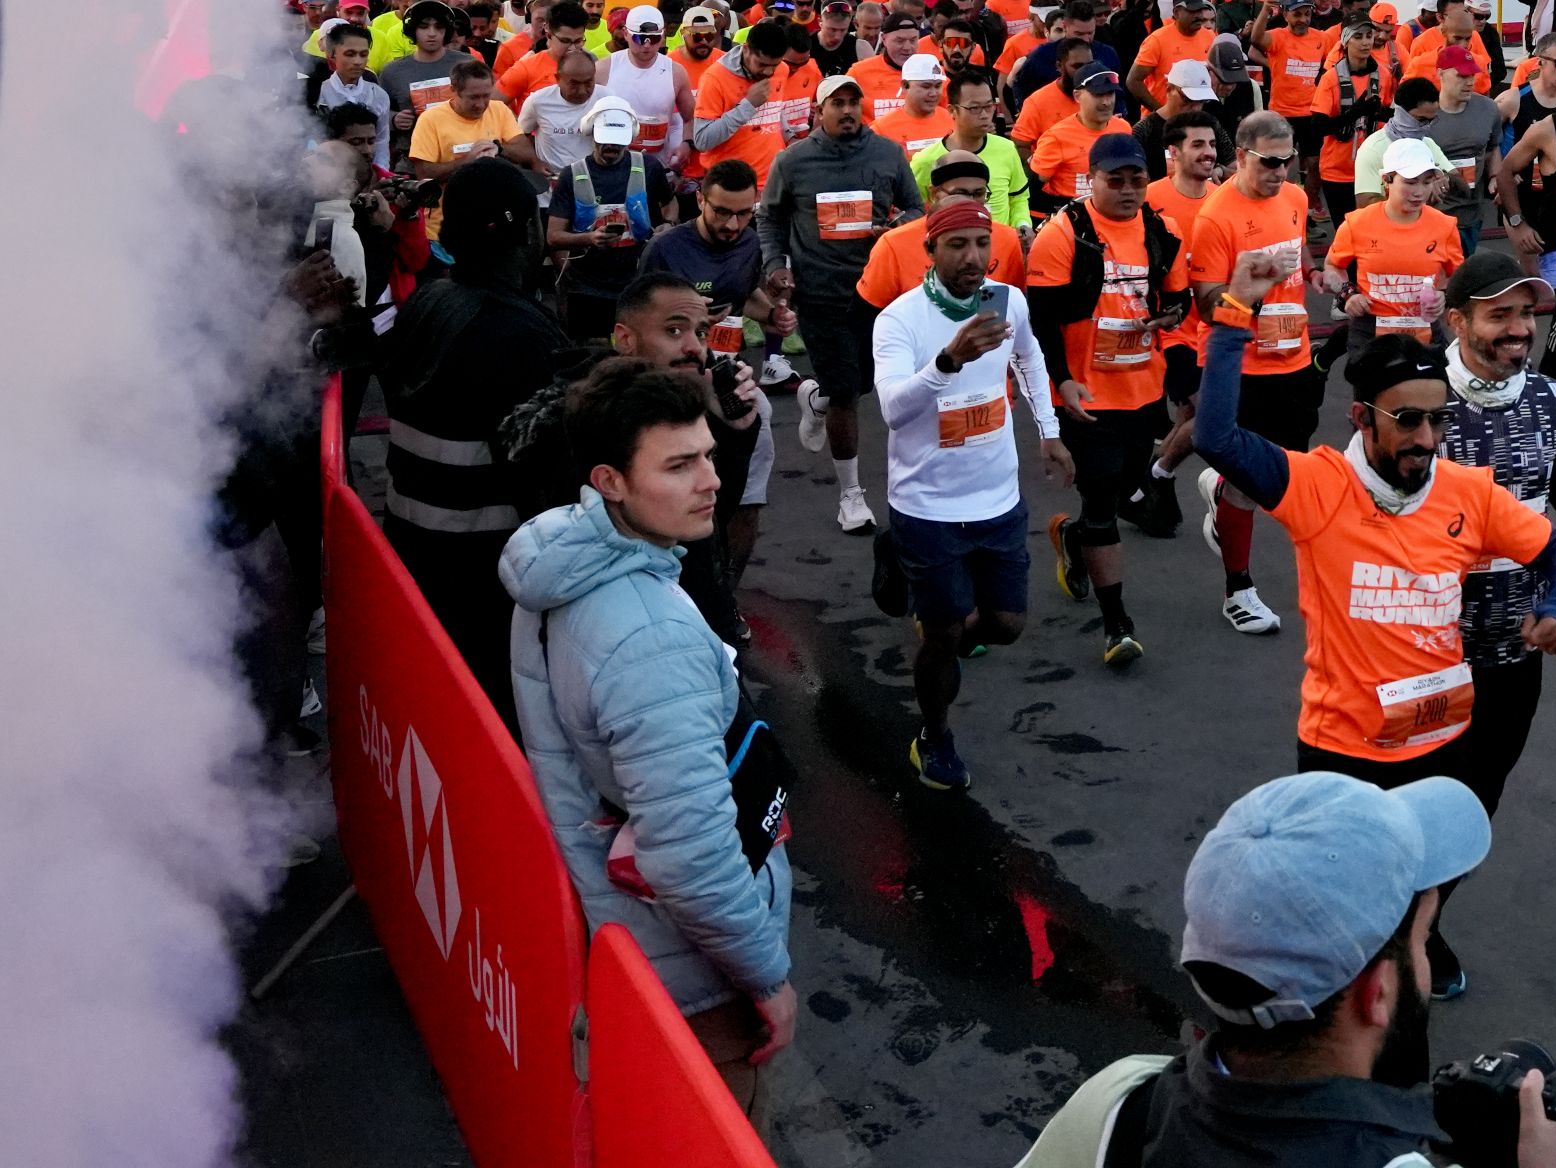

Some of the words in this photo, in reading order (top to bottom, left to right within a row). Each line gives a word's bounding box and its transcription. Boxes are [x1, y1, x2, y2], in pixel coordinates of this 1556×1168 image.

[965, 406, 990, 429] 1122
[1414, 695, 1448, 727] 1200
[359, 683, 394, 801] SAB
